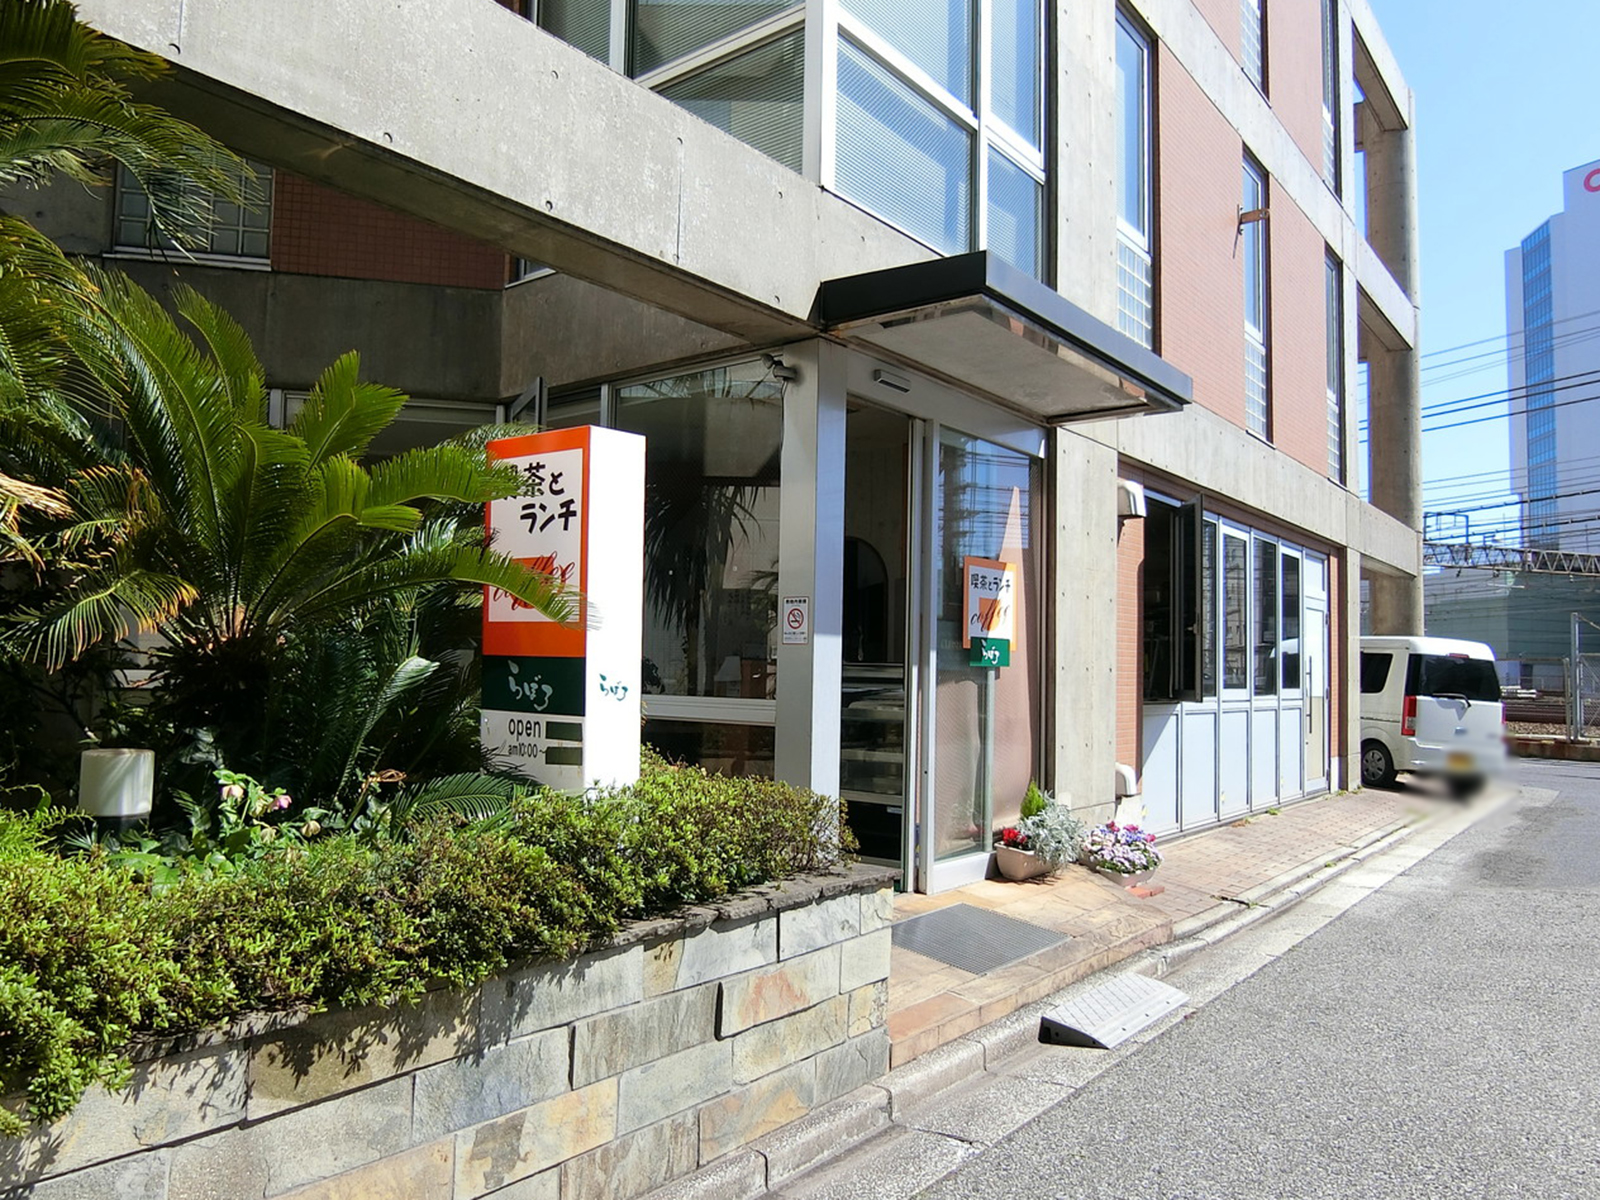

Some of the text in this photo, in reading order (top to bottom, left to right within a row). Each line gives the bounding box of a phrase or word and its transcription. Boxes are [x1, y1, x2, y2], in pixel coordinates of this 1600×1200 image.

[501, 461, 565, 500] 茶と
[520, 498, 577, 534] ランチ
[970, 599, 1010, 632] coffee
[508, 718, 542, 741] open
